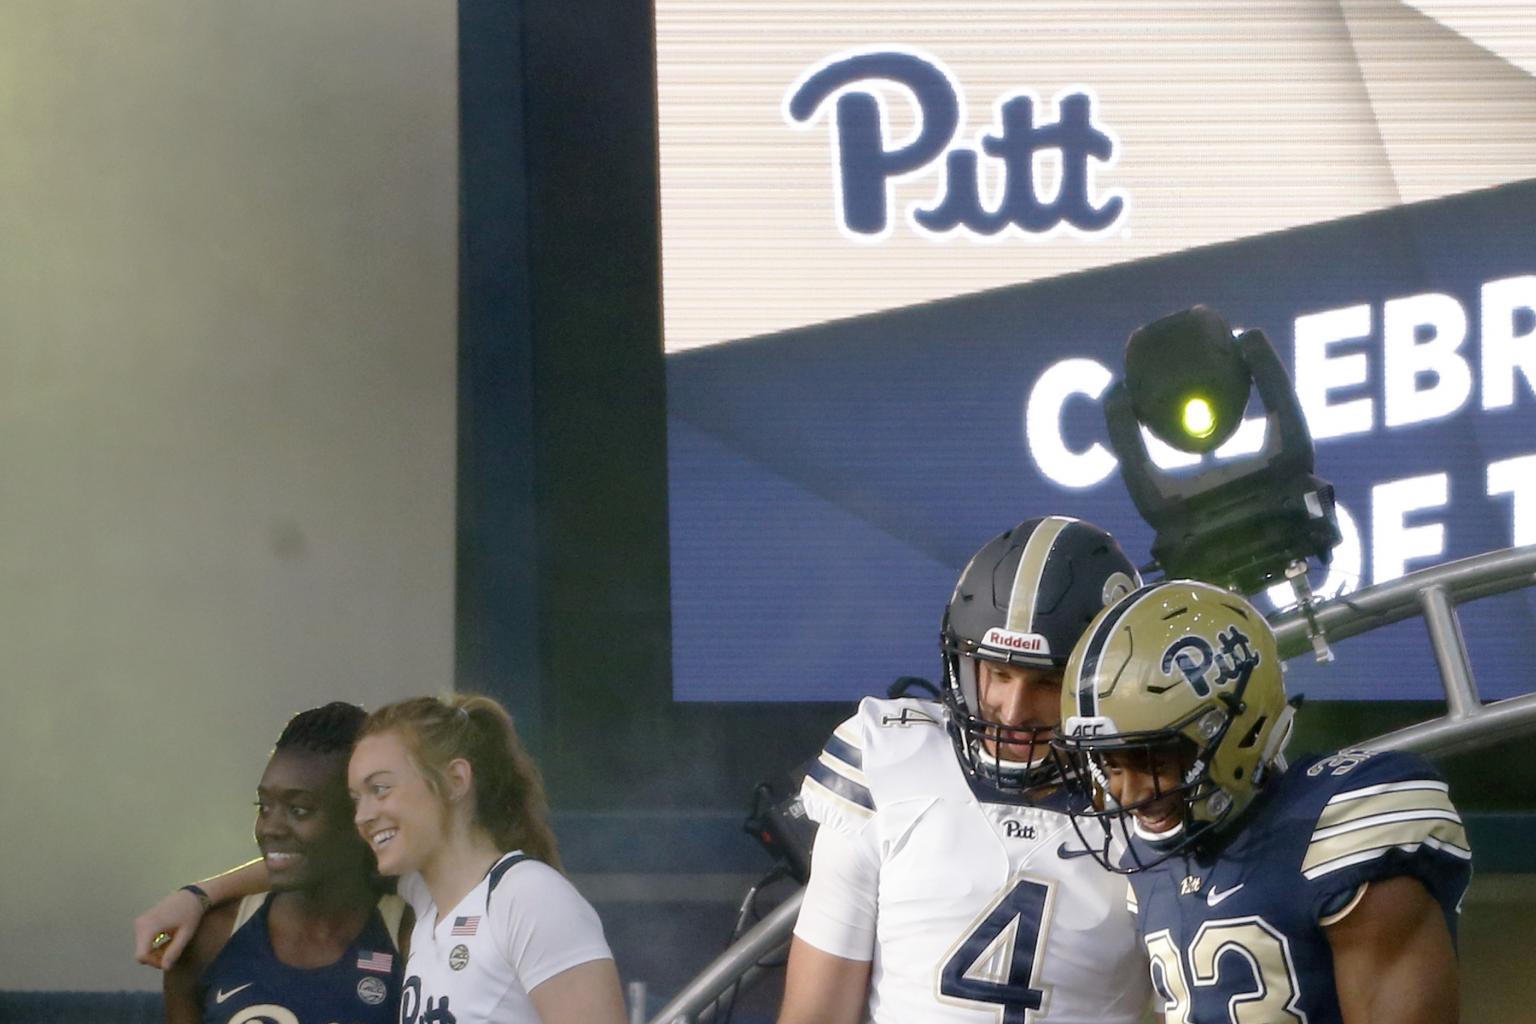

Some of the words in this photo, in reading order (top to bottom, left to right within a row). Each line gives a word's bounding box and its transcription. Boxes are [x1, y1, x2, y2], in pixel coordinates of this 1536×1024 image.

[787, 49, 1126, 237] Pitt
[990, 631, 1041, 650] Riddell
[1162, 625, 1259, 697] Pitt
[1003, 819, 1036, 840] Pitt
